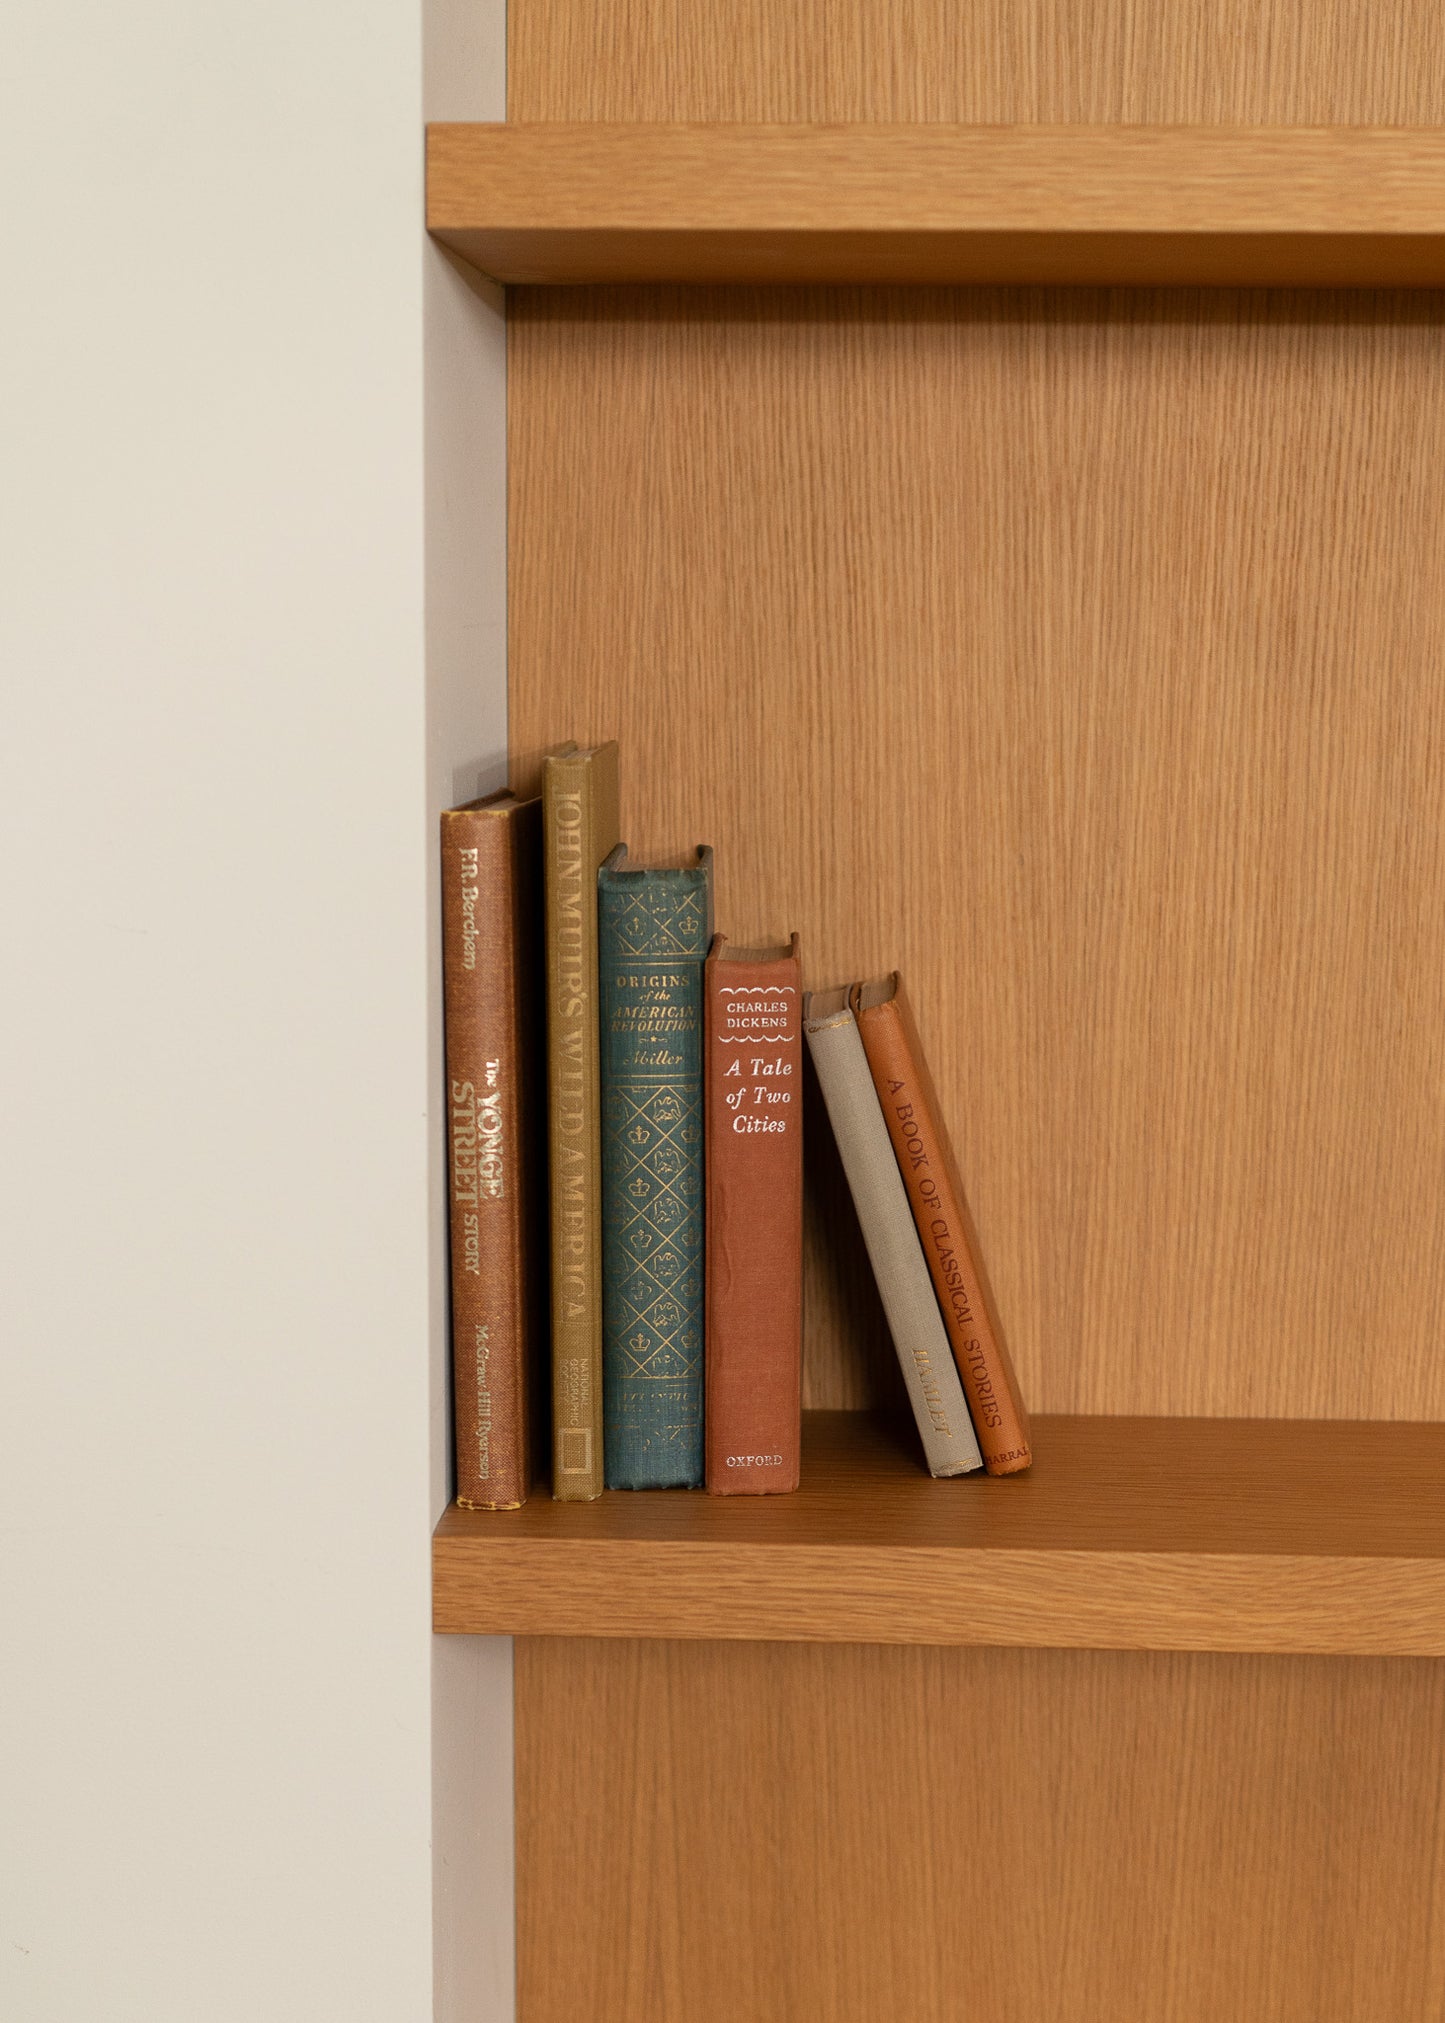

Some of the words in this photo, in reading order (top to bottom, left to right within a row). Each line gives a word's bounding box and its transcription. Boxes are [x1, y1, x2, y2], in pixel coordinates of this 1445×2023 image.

[553, 786, 582, 882] JOHN
[461, 886, 480, 971] Berchem
[556, 889, 588, 1018] MUIR'S
[616, 975, 689, 988] ORIGINS
[640, 990, 655, 1005] of
[654, 989, 671, 1001] the
[611, 1020, 696, 1032] REVOLUTION
[612, 1005, 695, 1018] AMERICAN
[726, 1002, 788, 1013] CHARLES
[727, 1017, 787, 1028] DICKENS
[484, 1058, 500, 1088] The
[623, 1050, 684, 1065] Miller
[723, 1059, 742, 1076] A
[750, 1058, 793, 1076] Tale
[558, 1027, 585, 1136] WILD
[726, 1088, 747, 1110] of
[753, 1086, 791, 1104] Two
[887, 1079, 905, 1096] A
[732, 1115, 786, 1133] Cities
[896, 1103, 930, 1171] BOOK
[452, 1080, 479, 1208] STREET
[477, 1090, 504, 1200] YONGE
[919, 1179, 942, 1210] OF
[464, 1213, 480, 1276] STORY
[559, 1144, 586, 1323] AMERICA
[930, 1219, 974, 1331] CLASSICAL
[580, 1359, 590, 1406] NATIONAL
[911, 1347, 953, 1438] HAMLET
[963, 1338, 1002, 1428] STORIES
[476, 1419, 492, 1480] Ryerson
[726, 1454, 783, 1468] OXFORD
